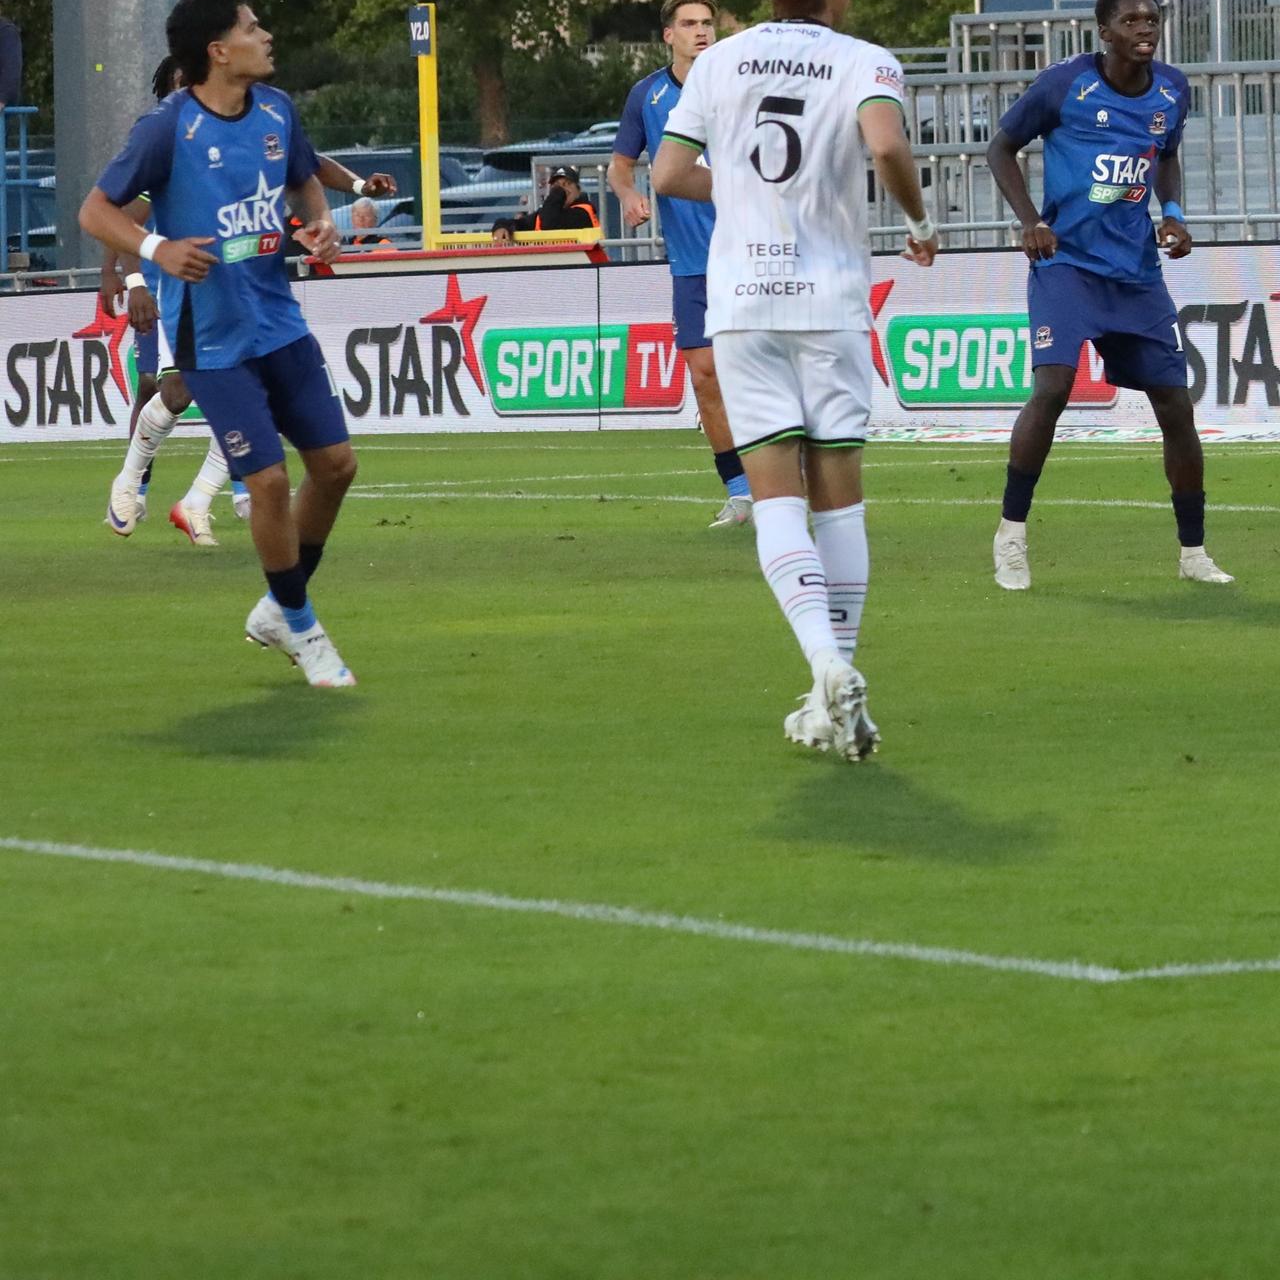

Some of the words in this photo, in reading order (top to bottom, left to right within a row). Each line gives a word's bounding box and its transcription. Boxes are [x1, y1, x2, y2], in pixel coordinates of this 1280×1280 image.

[738, 59, 833, 81] OMINAMI
[750, 95, 806, 184] 5
[1092, 153, 1151, 184] STAR
[1130, 188, 1143, 198] TV
[217, 200, 275, 239] STAR
[262, 236, 278, 250] TV
[746, 243, 801, 258] TEGEL
[735, 281, 816, 296] CONCEPT
[342, 322, 471, 418] STAR
[496, 336, 622, 401] SPORT
[636, 336, 680, 392] TV
[901, 326, 1033, 392] SPORT
[4, 338, 117, 427] STAR
